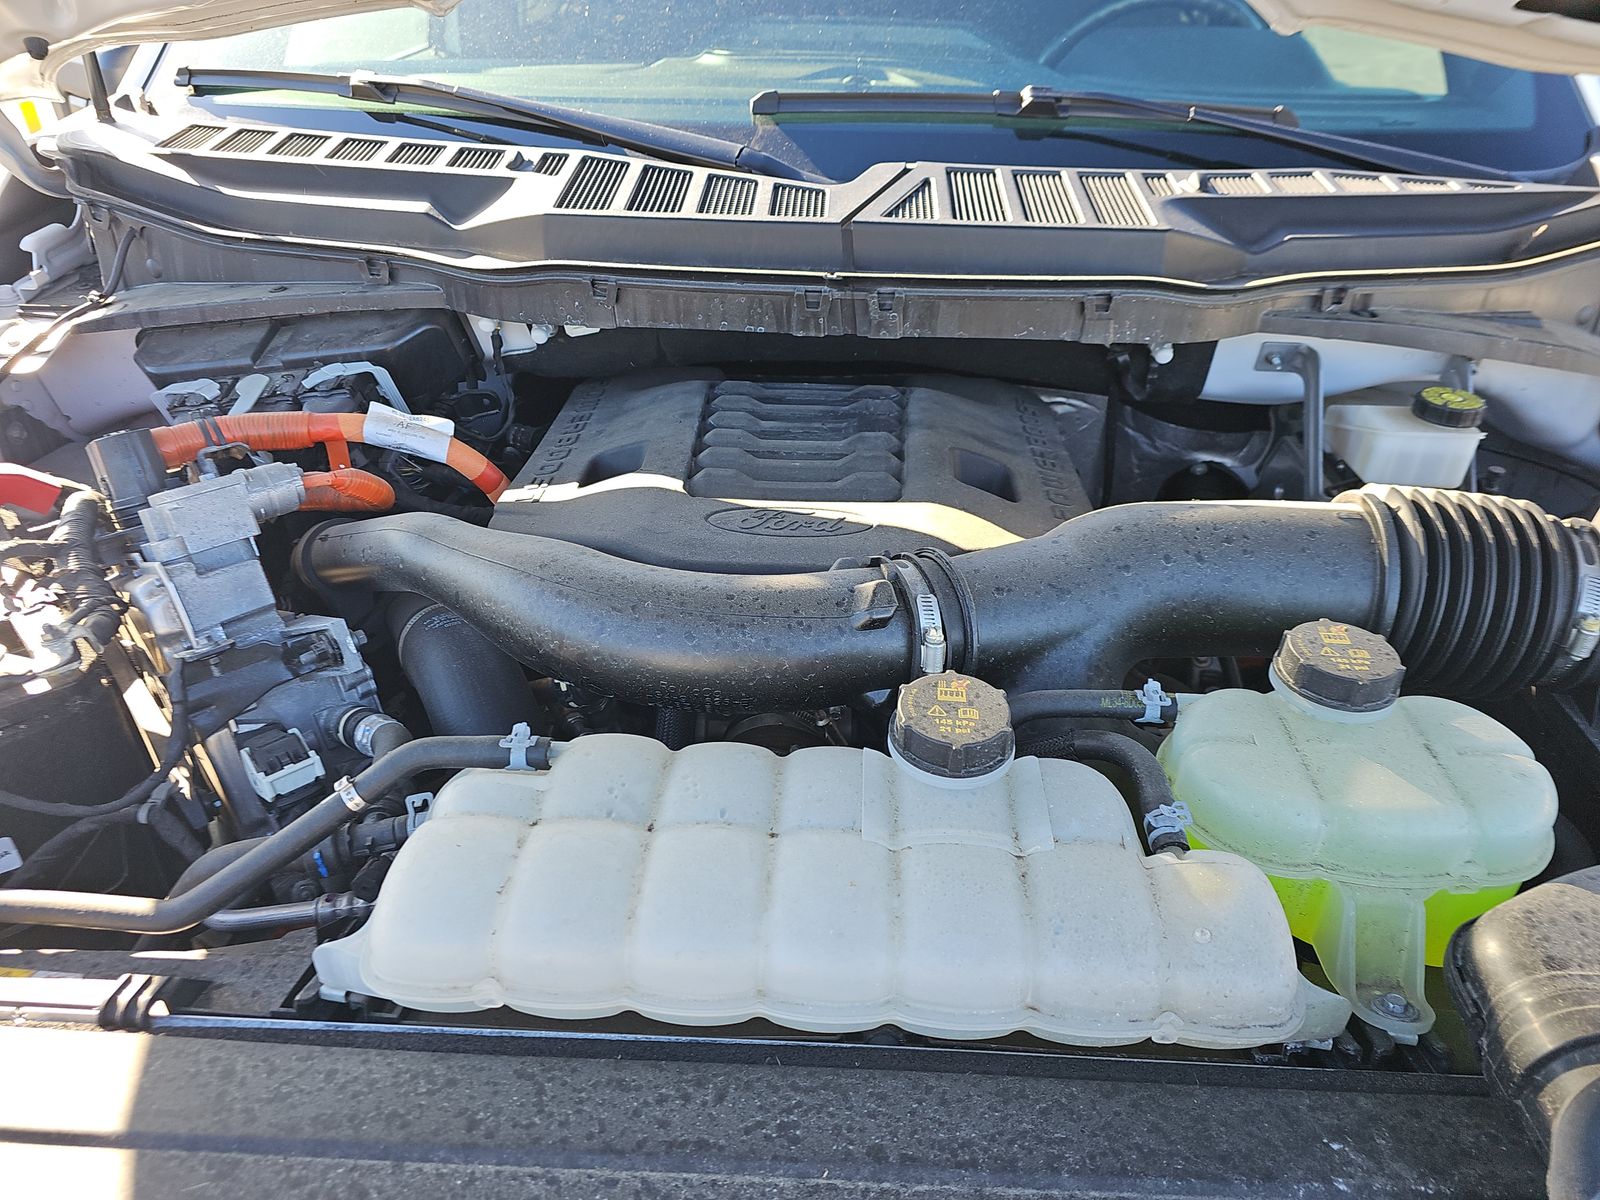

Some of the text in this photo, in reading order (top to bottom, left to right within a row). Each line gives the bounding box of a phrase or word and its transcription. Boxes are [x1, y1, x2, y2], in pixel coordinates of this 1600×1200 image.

[738, 509, 847, 533] Ford
[934, 718, 976, 727] 145 kPa
[955, 726, 971, 734] psi
